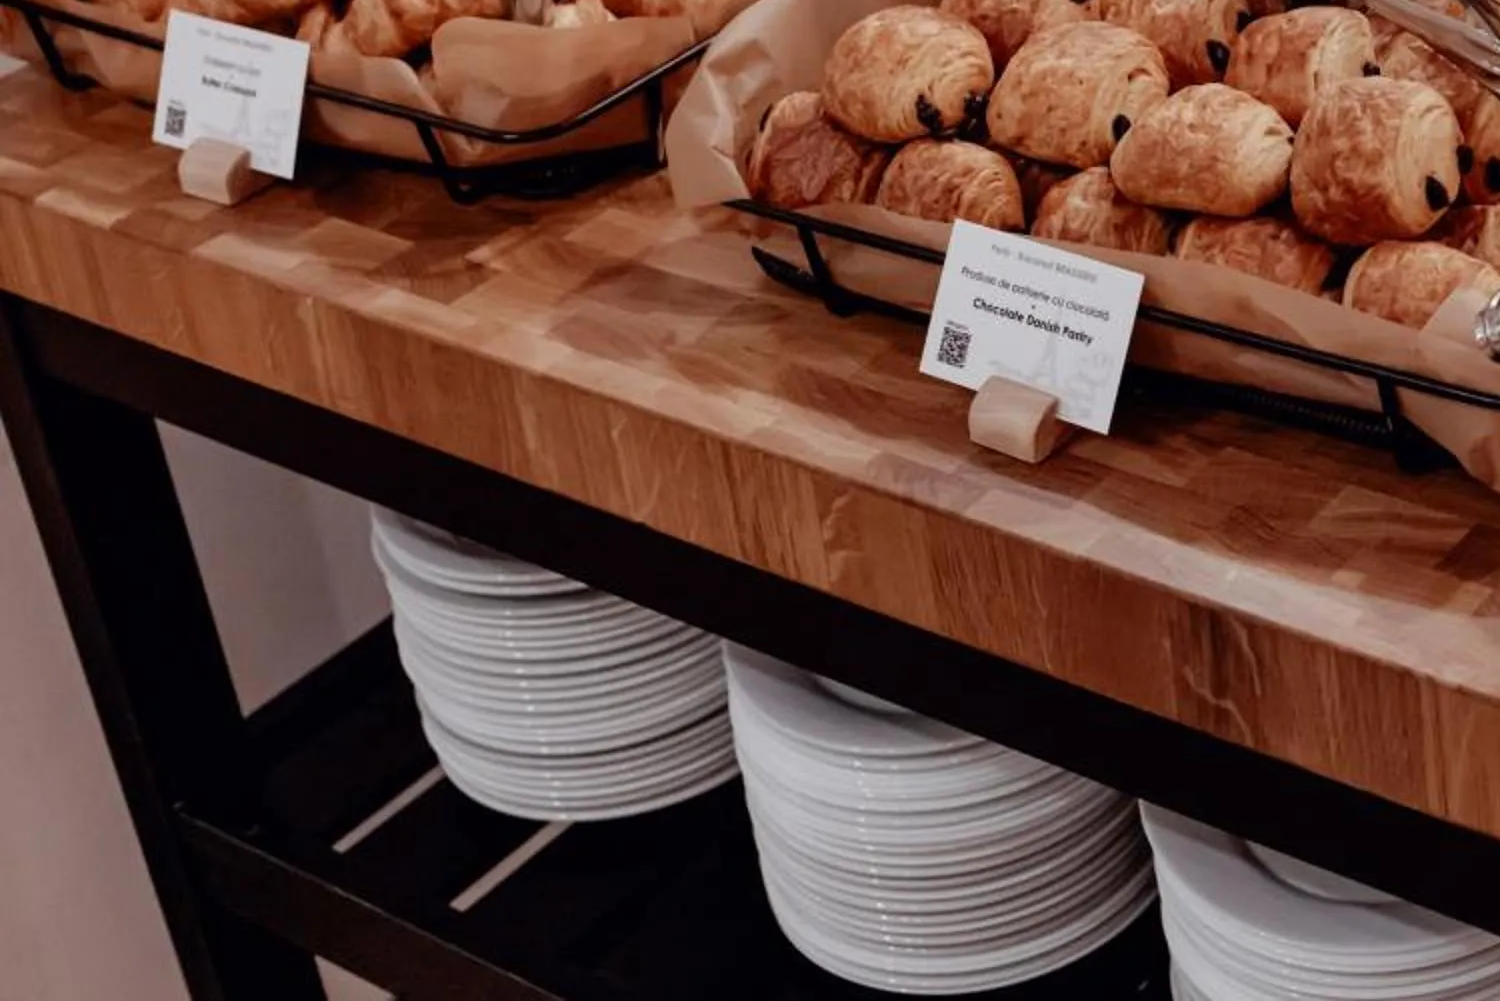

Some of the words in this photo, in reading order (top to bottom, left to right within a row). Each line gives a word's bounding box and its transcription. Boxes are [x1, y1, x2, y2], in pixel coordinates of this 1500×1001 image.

[998, 278, 1010, 290] de
[973, 298, 1025, 324] Chocolate
[1026, 312, 1061, 335] Danish
[1062, 325, 1094, 347] Pastry
